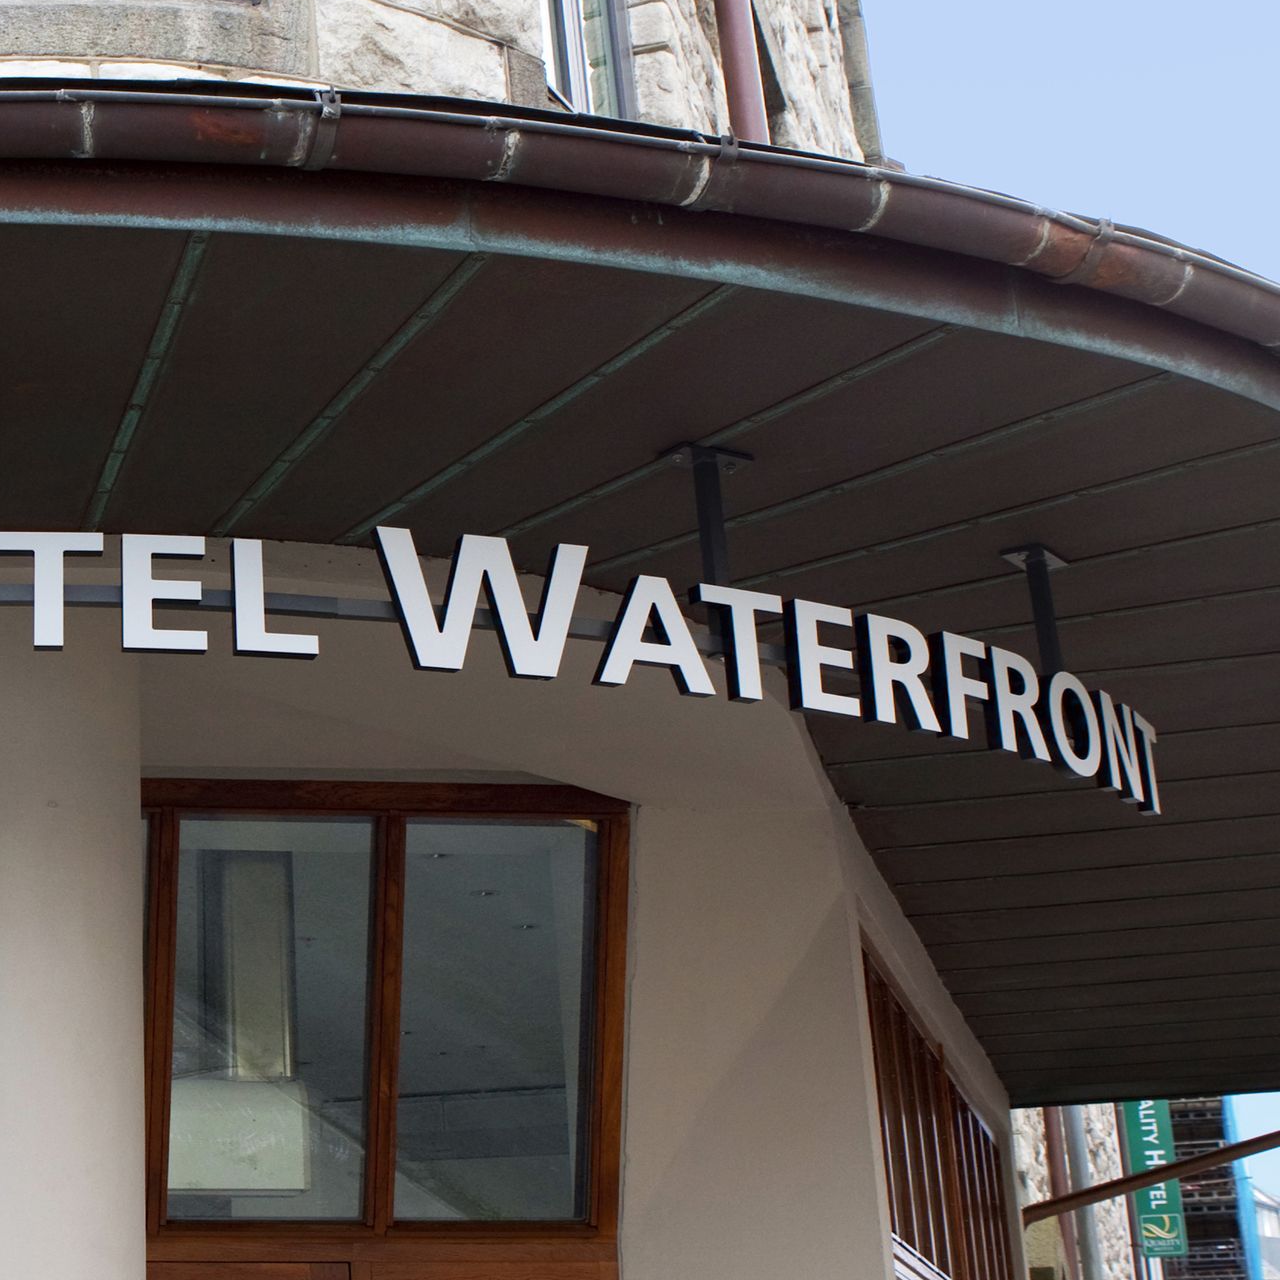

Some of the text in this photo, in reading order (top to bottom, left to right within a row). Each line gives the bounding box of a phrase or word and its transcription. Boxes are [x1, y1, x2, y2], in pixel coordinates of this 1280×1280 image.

[376, 525, 1161, 815] WATERFRONT
[1138, 1099, 1168, 1209] ALITY HTEL
